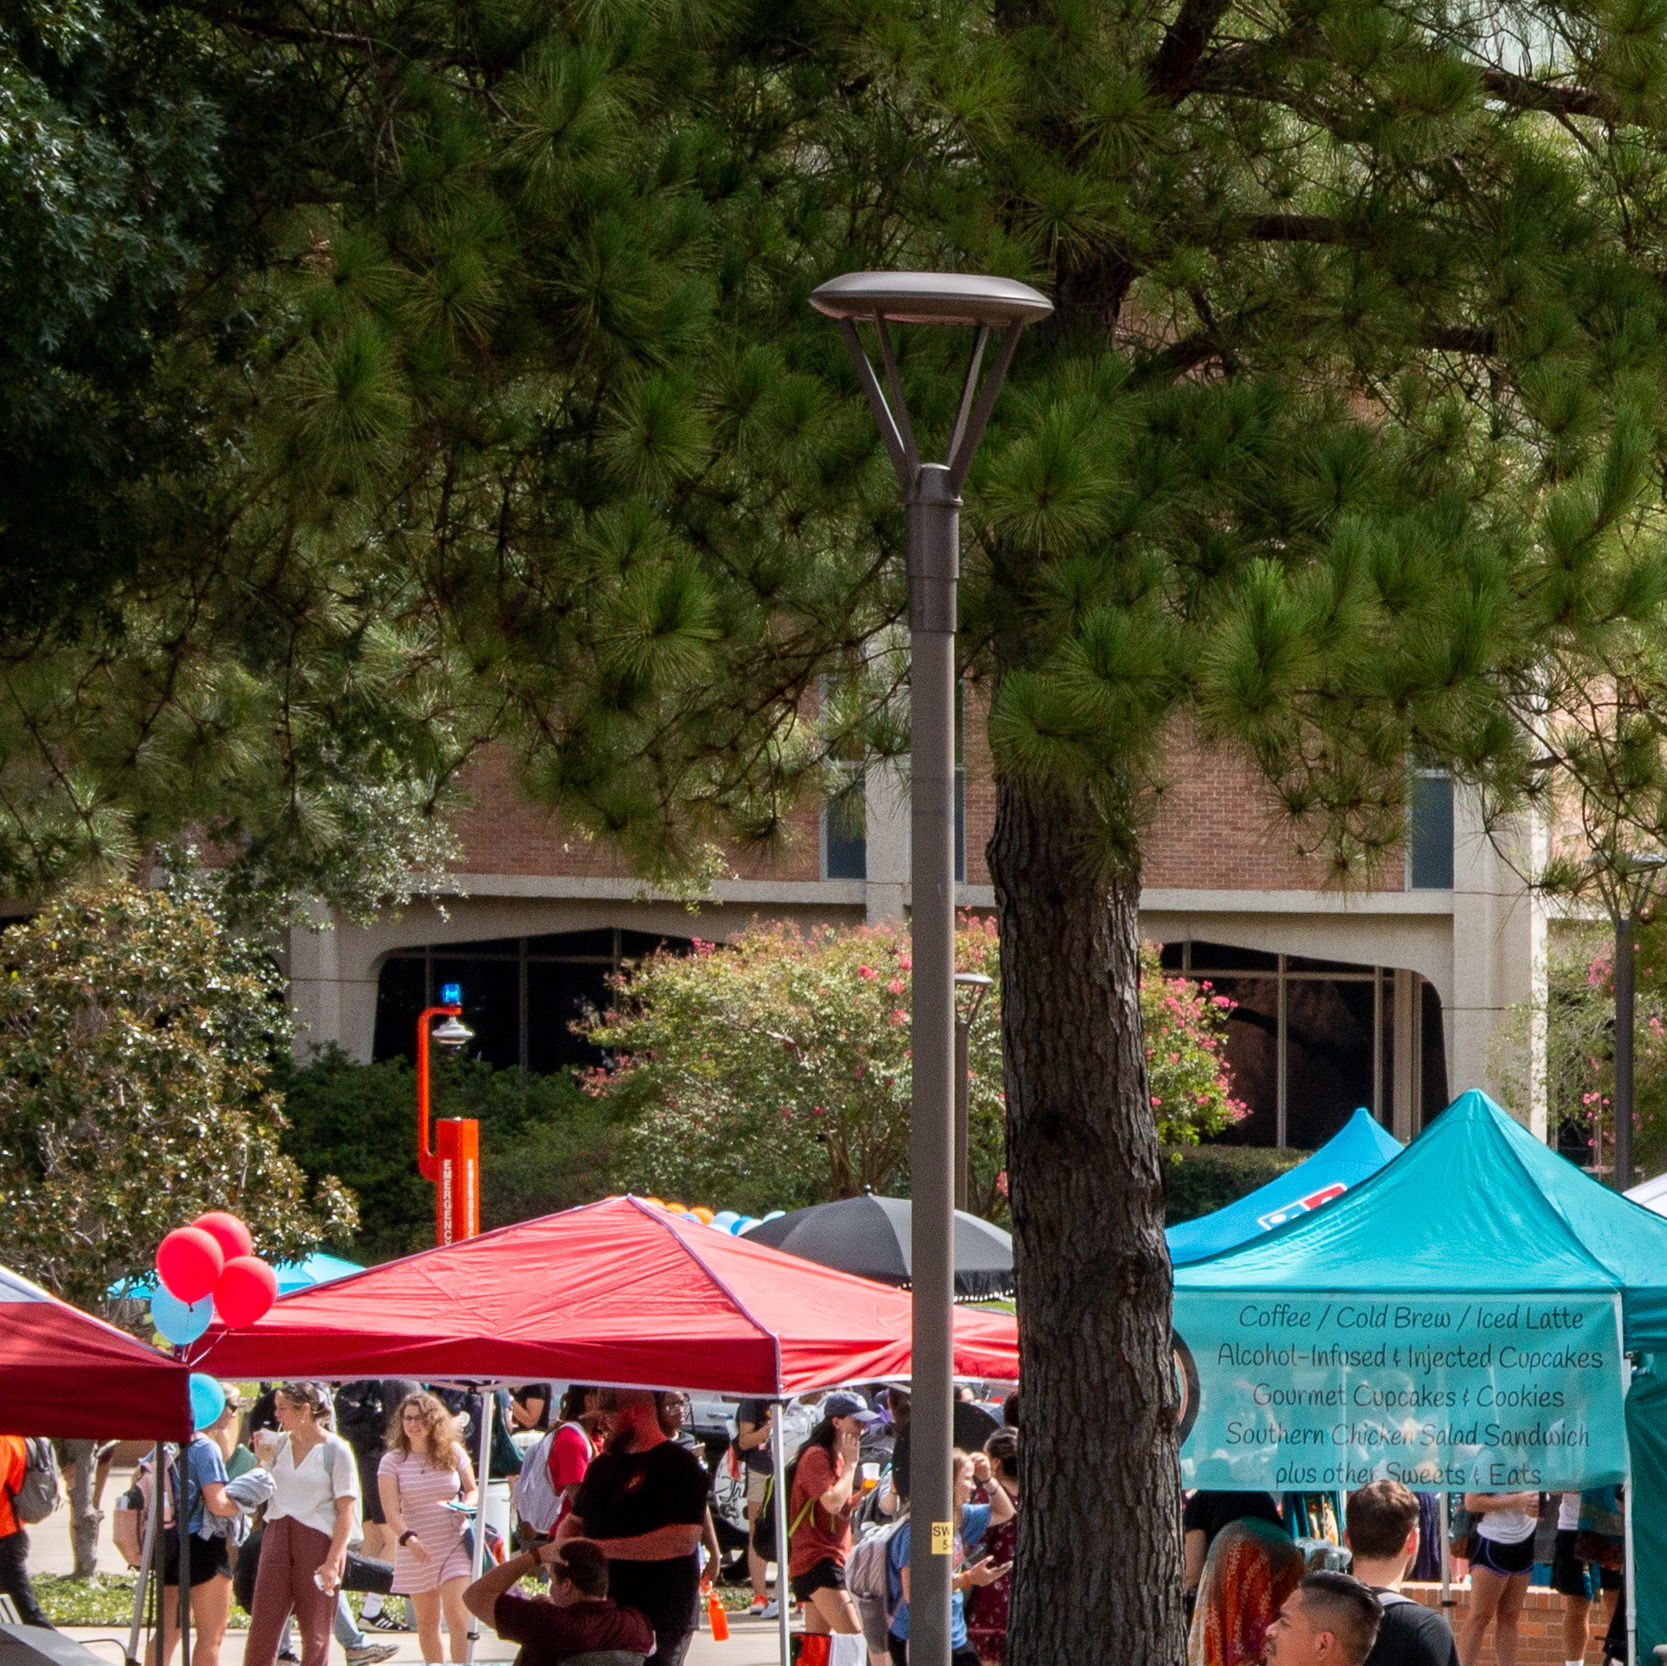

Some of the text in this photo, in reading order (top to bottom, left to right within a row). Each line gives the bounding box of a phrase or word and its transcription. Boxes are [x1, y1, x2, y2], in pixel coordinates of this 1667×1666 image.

[1238, 1304, 1311, 1329] Coffee
[1336, 1305, 1388, 1329] Cold
[1394, 1307, 1451, 1330] Brew
[1477, 1304, 1522, 1330] Iced
[1526, 1306, 1584, 1330] Latte
[1217, 1343, 1387, 1368] Alcohol-Infused
[1407, 1343, 1492, 1374] Injected
[1499, 1347, 1604, 1374] Cupcakes
[1252, 1384, 1347, 1408] Gourmet
[1353, 1384, 1456, 1412] Cupcakes
[1476, 1384, 1565, 1408] Cookies
[1226, 1421, 1590, 1448] Southern Chicken Salad Sandwich
[1275, 1465, 1317, 1489] plus
[1322, 1466, 1379, 1485] other
[1386, 1464, 1465, 1486] Sweets
[1489, 1464, 1541, 1486] Eats
